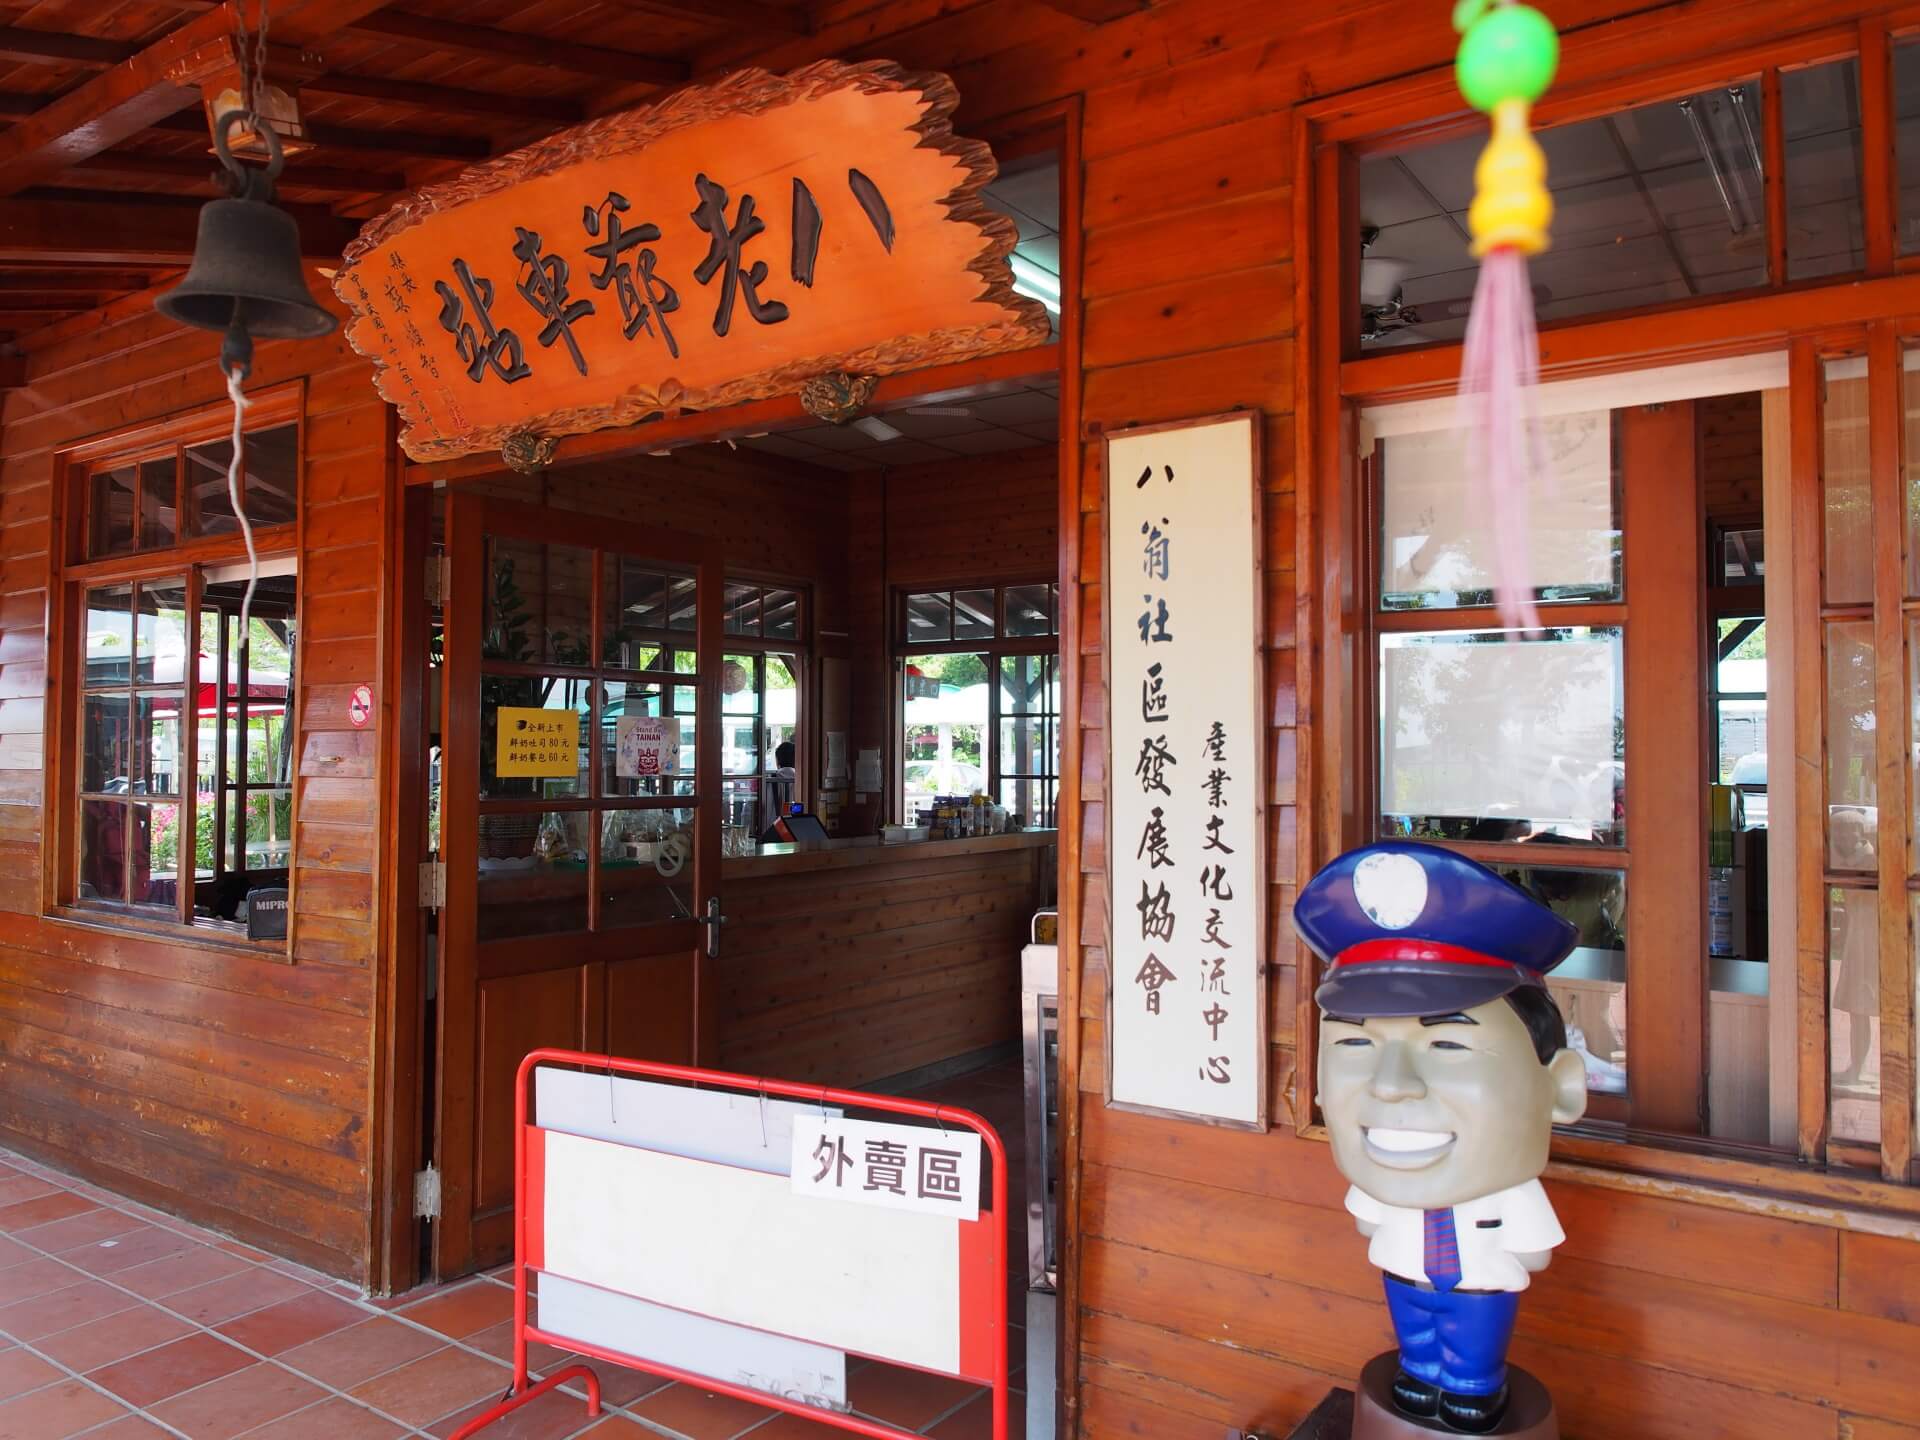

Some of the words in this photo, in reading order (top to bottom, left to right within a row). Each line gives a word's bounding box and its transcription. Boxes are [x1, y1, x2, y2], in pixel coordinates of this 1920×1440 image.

[636, 733, 661, 741] TAINAN
[1135, 464, 1177, 1016] 八翁社區發展協會
[1199, 720, 1235, 1085] 產業文化交流中心
[812, 1133, 962, 1202] 外賣區
